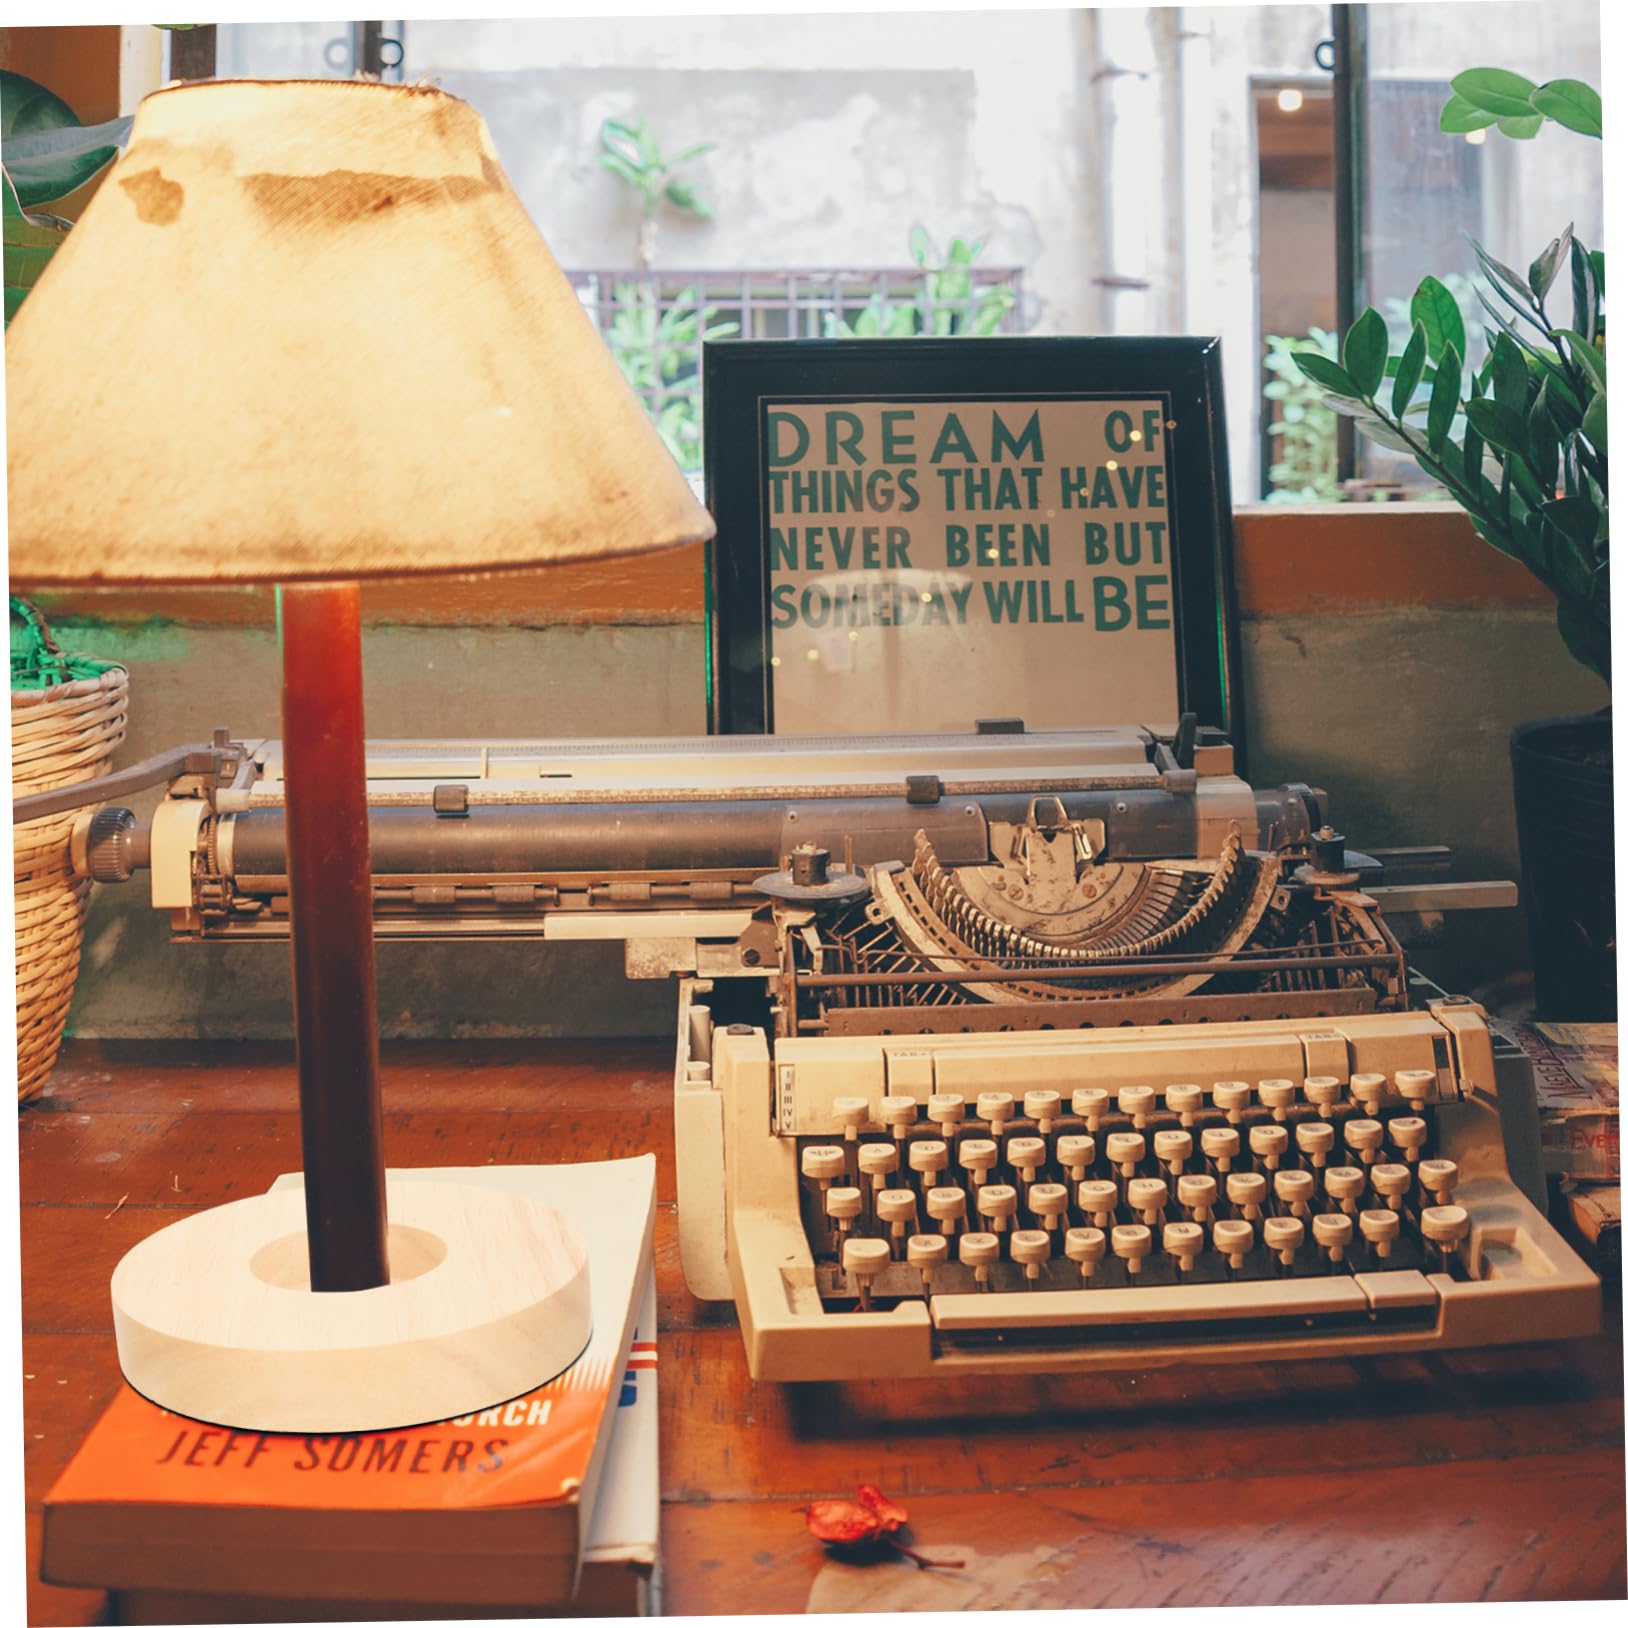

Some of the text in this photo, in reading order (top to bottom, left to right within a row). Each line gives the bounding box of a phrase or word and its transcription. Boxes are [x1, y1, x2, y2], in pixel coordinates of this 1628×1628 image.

[768, 409, 1160, 467] DREAM OF
[771, 465, 1166, 514] THINGS THAT HAVE
[771, 521, 1167, 571] NEVER BEEN BUT
[771, 574, 1171, 632] SOMEDAY WILL BE
[438, 1399, 552, 1427] RCH
[156, 1430, 271, 1468] JEFF
[294, 1435, 509, 1474] SOMERS
